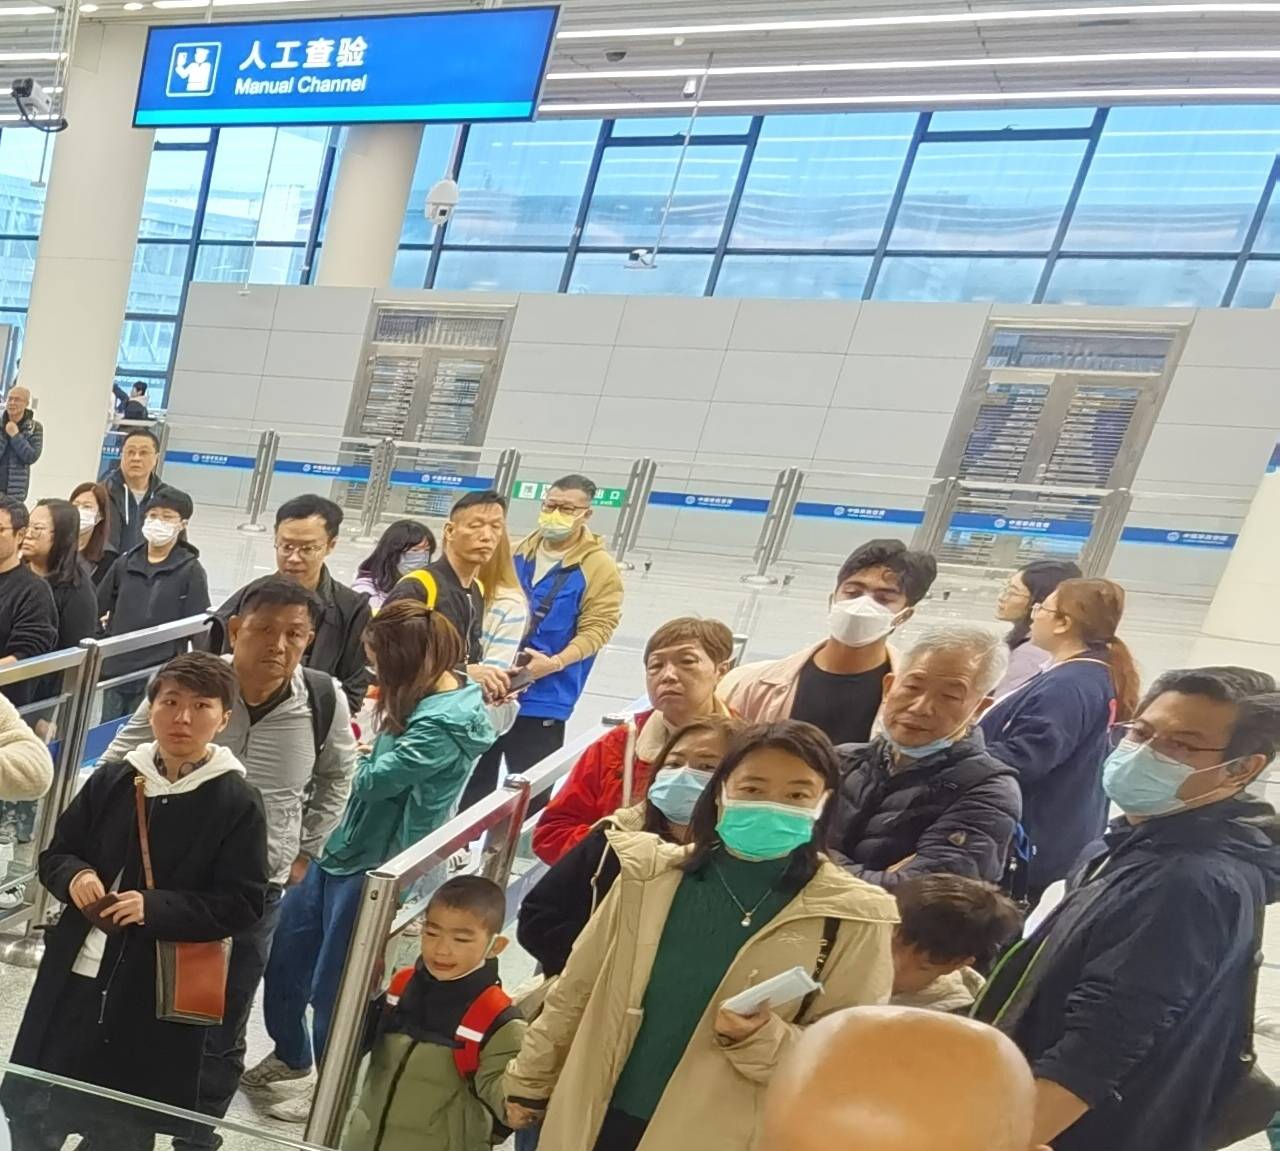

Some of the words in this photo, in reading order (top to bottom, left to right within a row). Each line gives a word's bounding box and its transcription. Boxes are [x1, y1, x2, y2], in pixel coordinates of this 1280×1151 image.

[238, 36, 368, 71] 人工查验
[235, 77, 292, 96] Manual
[298, 74, 367, 94] Channel
